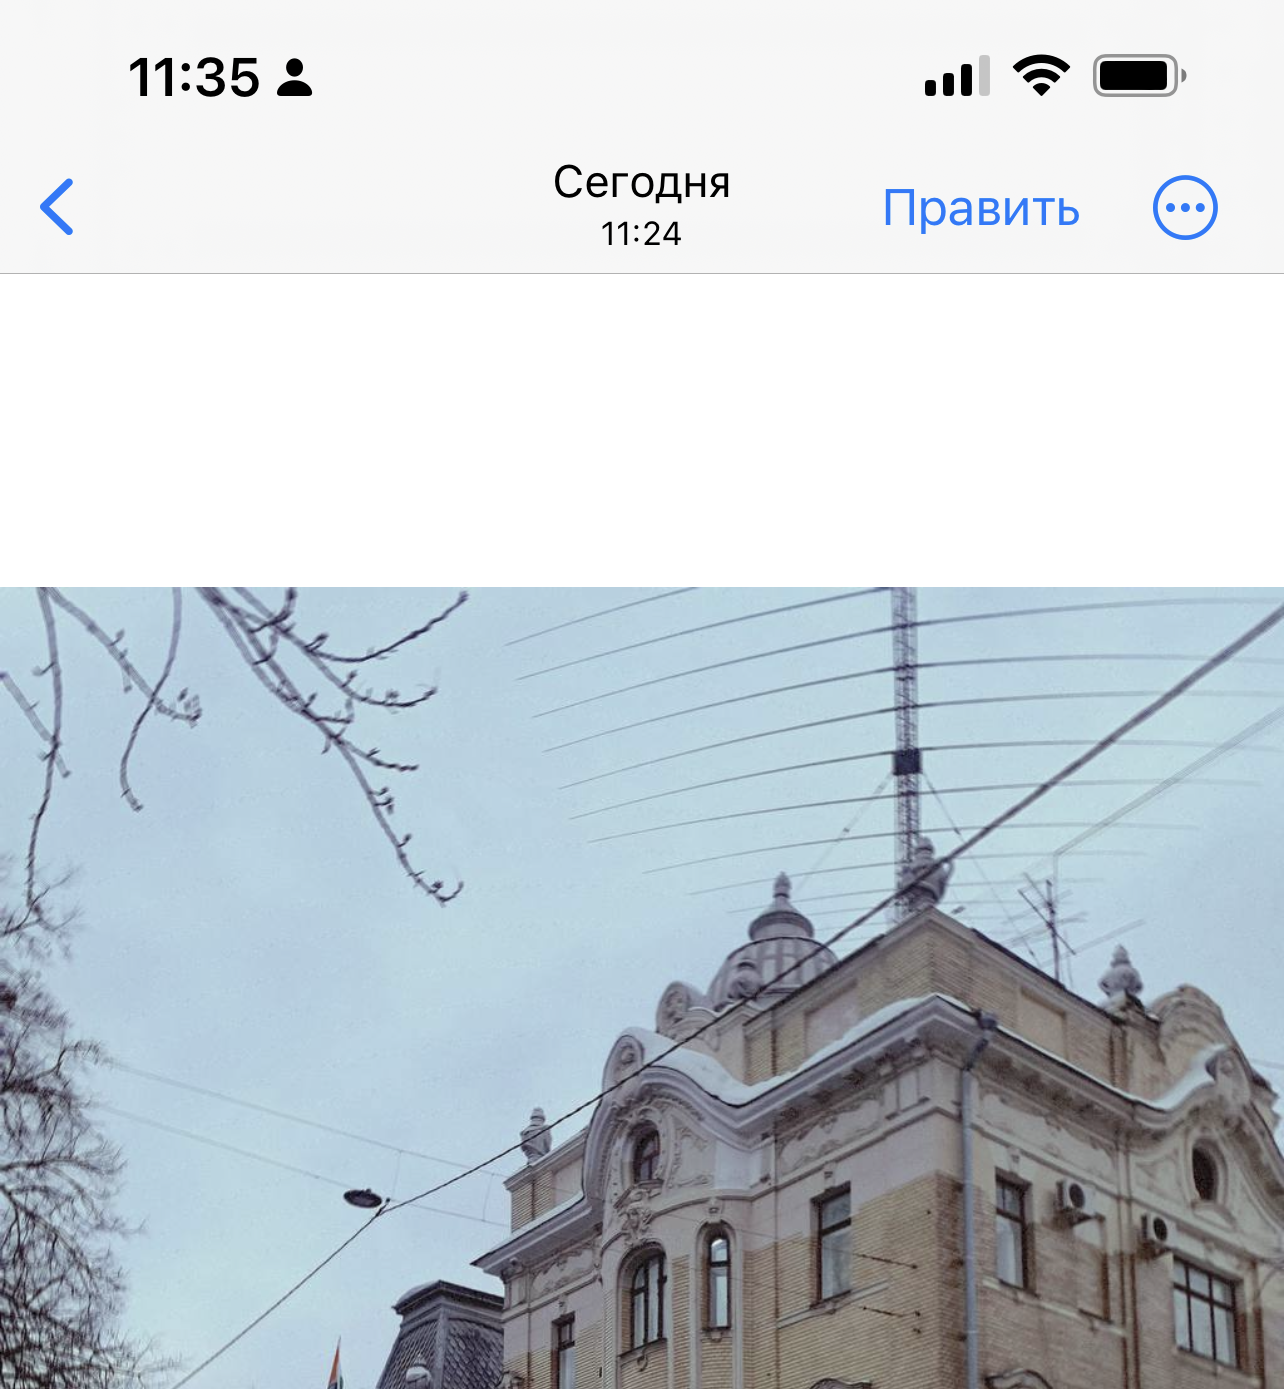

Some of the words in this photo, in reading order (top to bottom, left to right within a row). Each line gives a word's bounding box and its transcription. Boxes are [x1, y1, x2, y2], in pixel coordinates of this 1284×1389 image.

[130, 57, 260, 98] 11:35
[555, 164, 729, 204] Сегодня
[885, 189, 1080, 235] Править
[601, 220, 682, 246] 11:24
